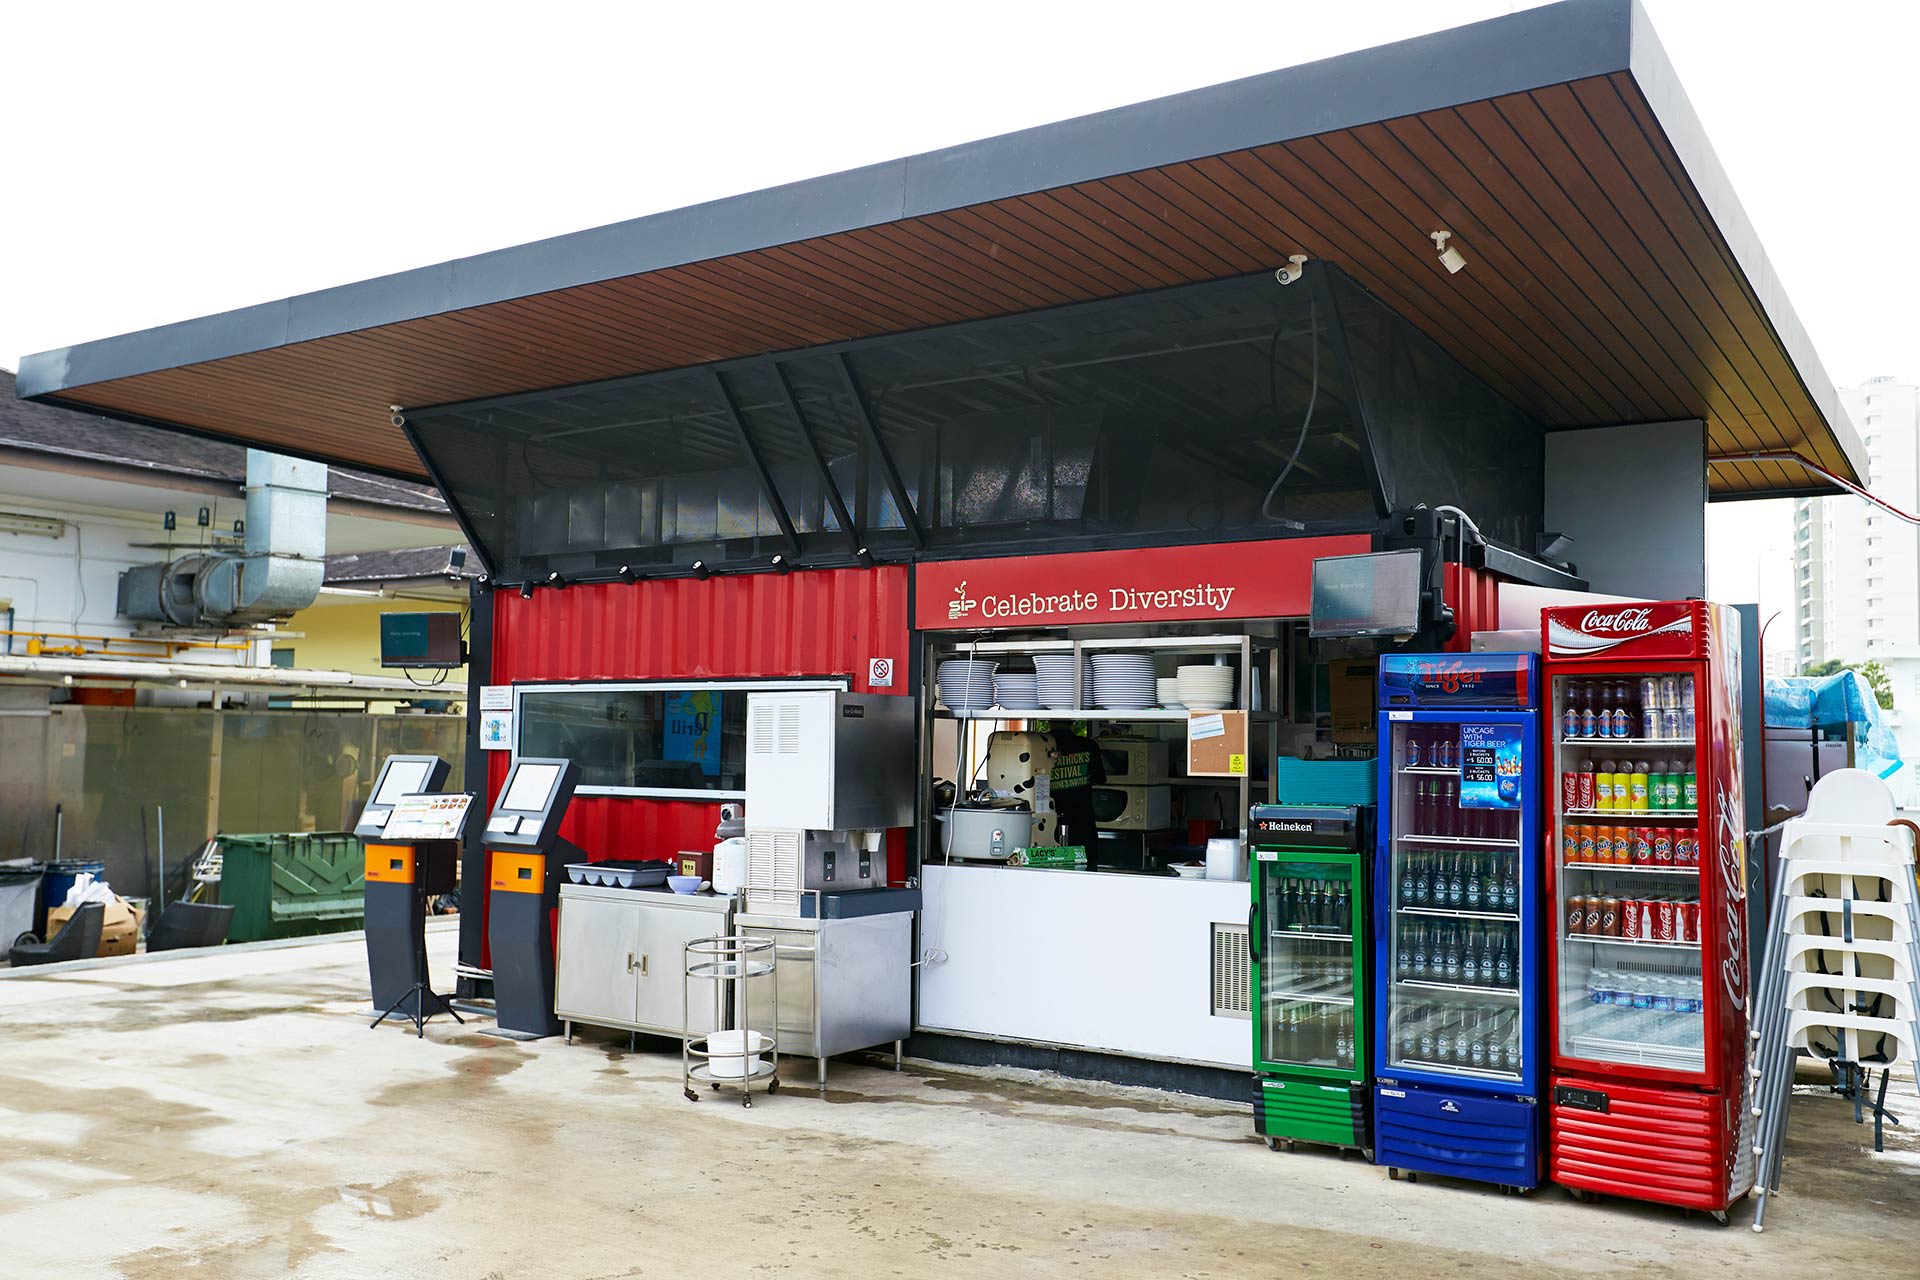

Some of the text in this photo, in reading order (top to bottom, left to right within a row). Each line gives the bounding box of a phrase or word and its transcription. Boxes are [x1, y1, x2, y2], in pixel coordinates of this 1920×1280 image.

[981, 584, 1235, 618] Celebrate Diversity
[1580, 608, 1654, 633] Coca-Cola
[1419, 660, 1486, 693] Tiger
[1486, 740, 1506, 748] BEER
[1050, 765, 1082, 780] ESTIVAL
[1268, 821, 1313, 832] Heineken
[1030, 849, 1056, 858] LACY'S
